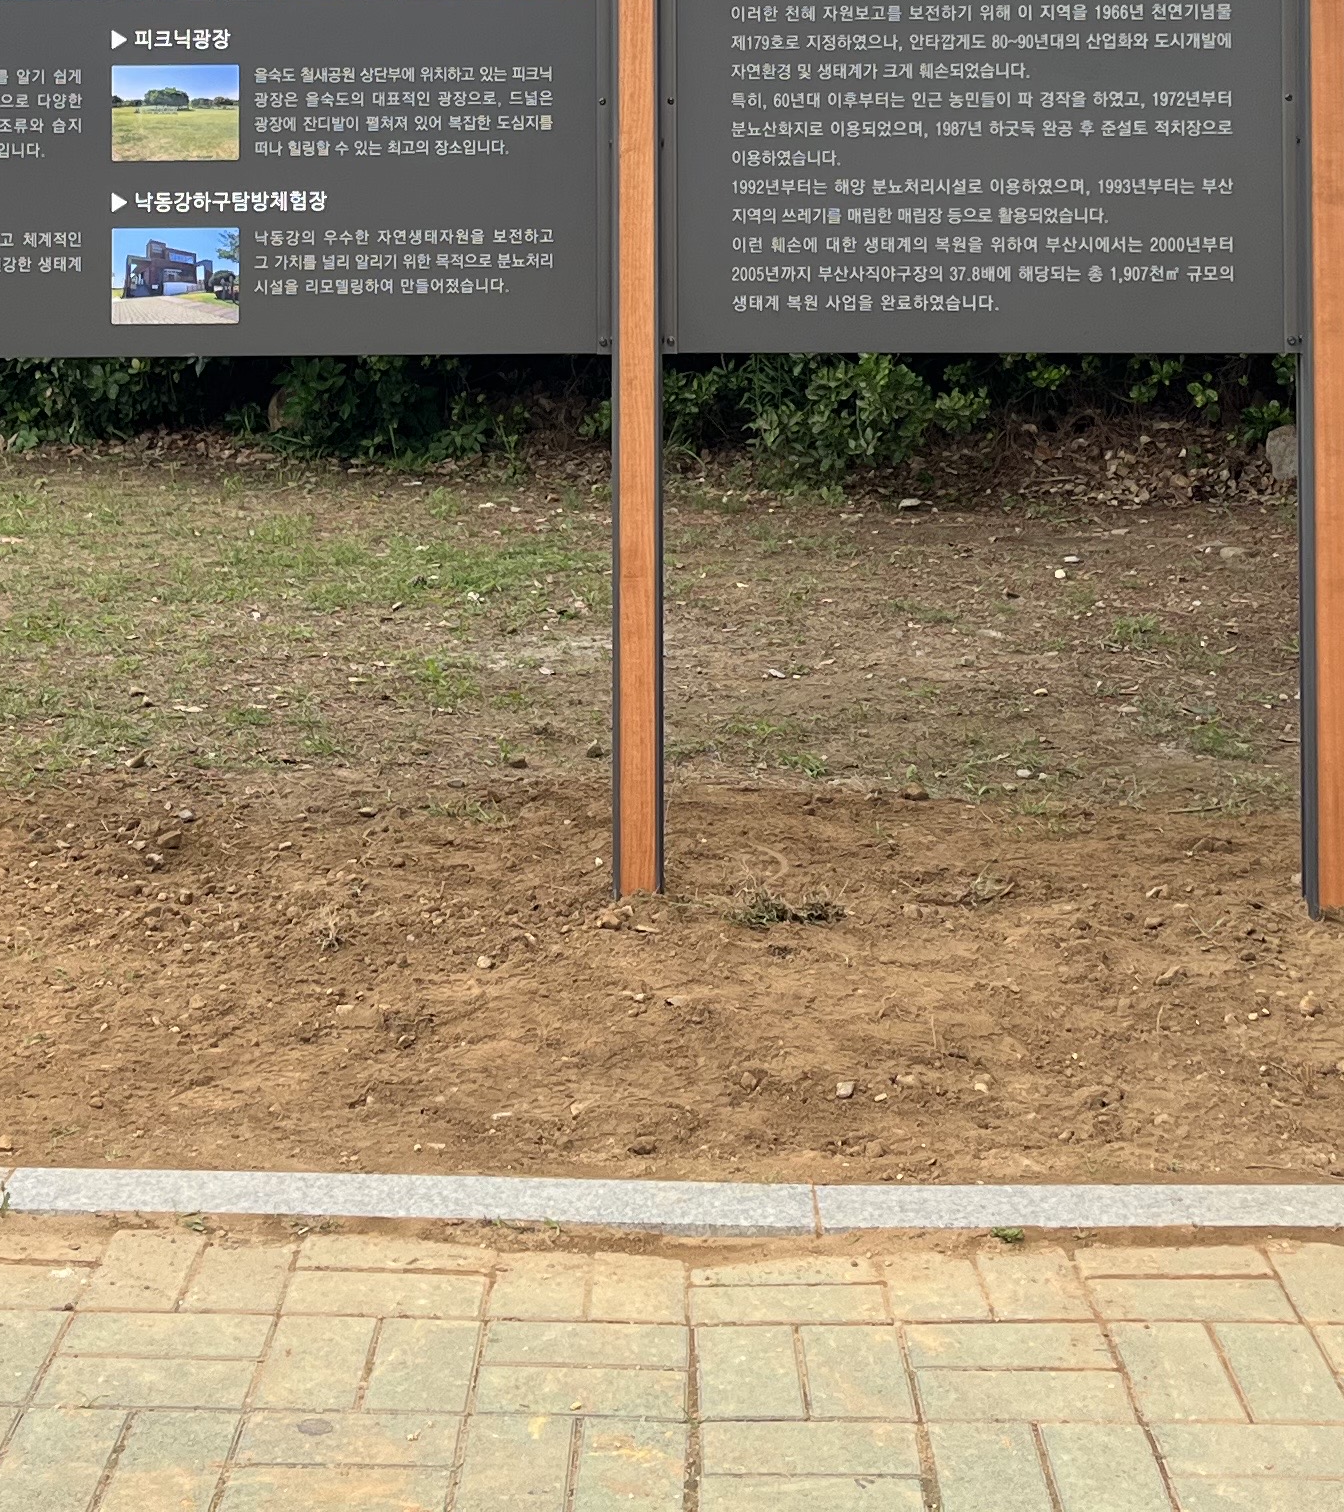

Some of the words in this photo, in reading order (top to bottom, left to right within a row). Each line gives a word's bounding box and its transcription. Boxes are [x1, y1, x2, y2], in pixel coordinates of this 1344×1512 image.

[134, 28, 231, 49] 피크닉광장
[730, 34, 800, 50] 제179호로
[805, 34, 902, 51] 지정하였으나,
[909, 33, 986, 50] 안타깝게도
[991, 33, 1079, 49] 80~90년대의
[1085, 32, 1148, 49] 산업화와
[1153, 32, 1231, 49] 도시개발에
[16, 68, 44, 84] 알기
[53, 68, 81, 84] 쉽게
[730, 63, 790, 80] 자연환경
[797, 63, 811, 79] 및
[816, 63, 878, 80] 생태계가
[882, 62, 912, 79] 크게
[918, 62, 1030, 79] 훼손되었습니다.
[37, 93, 82, 109] 다양한
[51, 117, 81, 133] 습지
[731, 179, 827, 195] 1992년부터는
[834, 178, 865, 195] 해양
[871, 178, 983, 195] 분뇨처리시설로
[989, 178, 1090, 195] 이용하였으며,
[1097, 178, 1195, 194] 1993년부터는
[1201, 178, 1233, 194] 부산
[135, 190, 327, 212] 낙동강하구탐방체험장
[22, 231, 81, 247] 체계적인
[254, 230, 314, 246] 낙동강의
[323, 229, 369, 245] 우수한
[376, 228, 484, 245] 자연생태자원을
[492, 228, 554, 244] 보전하고
[732, 236, 762, 253] 이런
[770, 236, 817, 253] 훼손에
[826, 236, 857, 253] 대한
[863, 236, 927, 253] 생태계의
[934, 236, 983, 253] 복원을
[990, 236, 1037, 253] 위하여
[1045, 236, 1143, 253] 부산시에서는
[1149, 236, 1233, 252] 2000년부터
[37, 256, 81, 272] 생태계
[254, 255, 268, 268] 그
[274, 254, 316, 270] 가치를
[322, 254, 349, 270] 널리
[355, 254, 396, 270] 알리기
[402, 253, 431, 269] 위한
[435, 253, 492, 269] 목적으로
[497, 253, 553, 268] 분뇨처리
[253, 278, 298, 295] 시설을
[305, 278, 393, 294] 리모델링하여
[400, 278, 509, 294] 만들어졌습니다.
[732, 295, 779, 312] 생태계
[786, 294, 817, 311] 복원
[825, 294, 873, 311] 사업을
[880, 294, 999, 311] 완료하였습니다.
